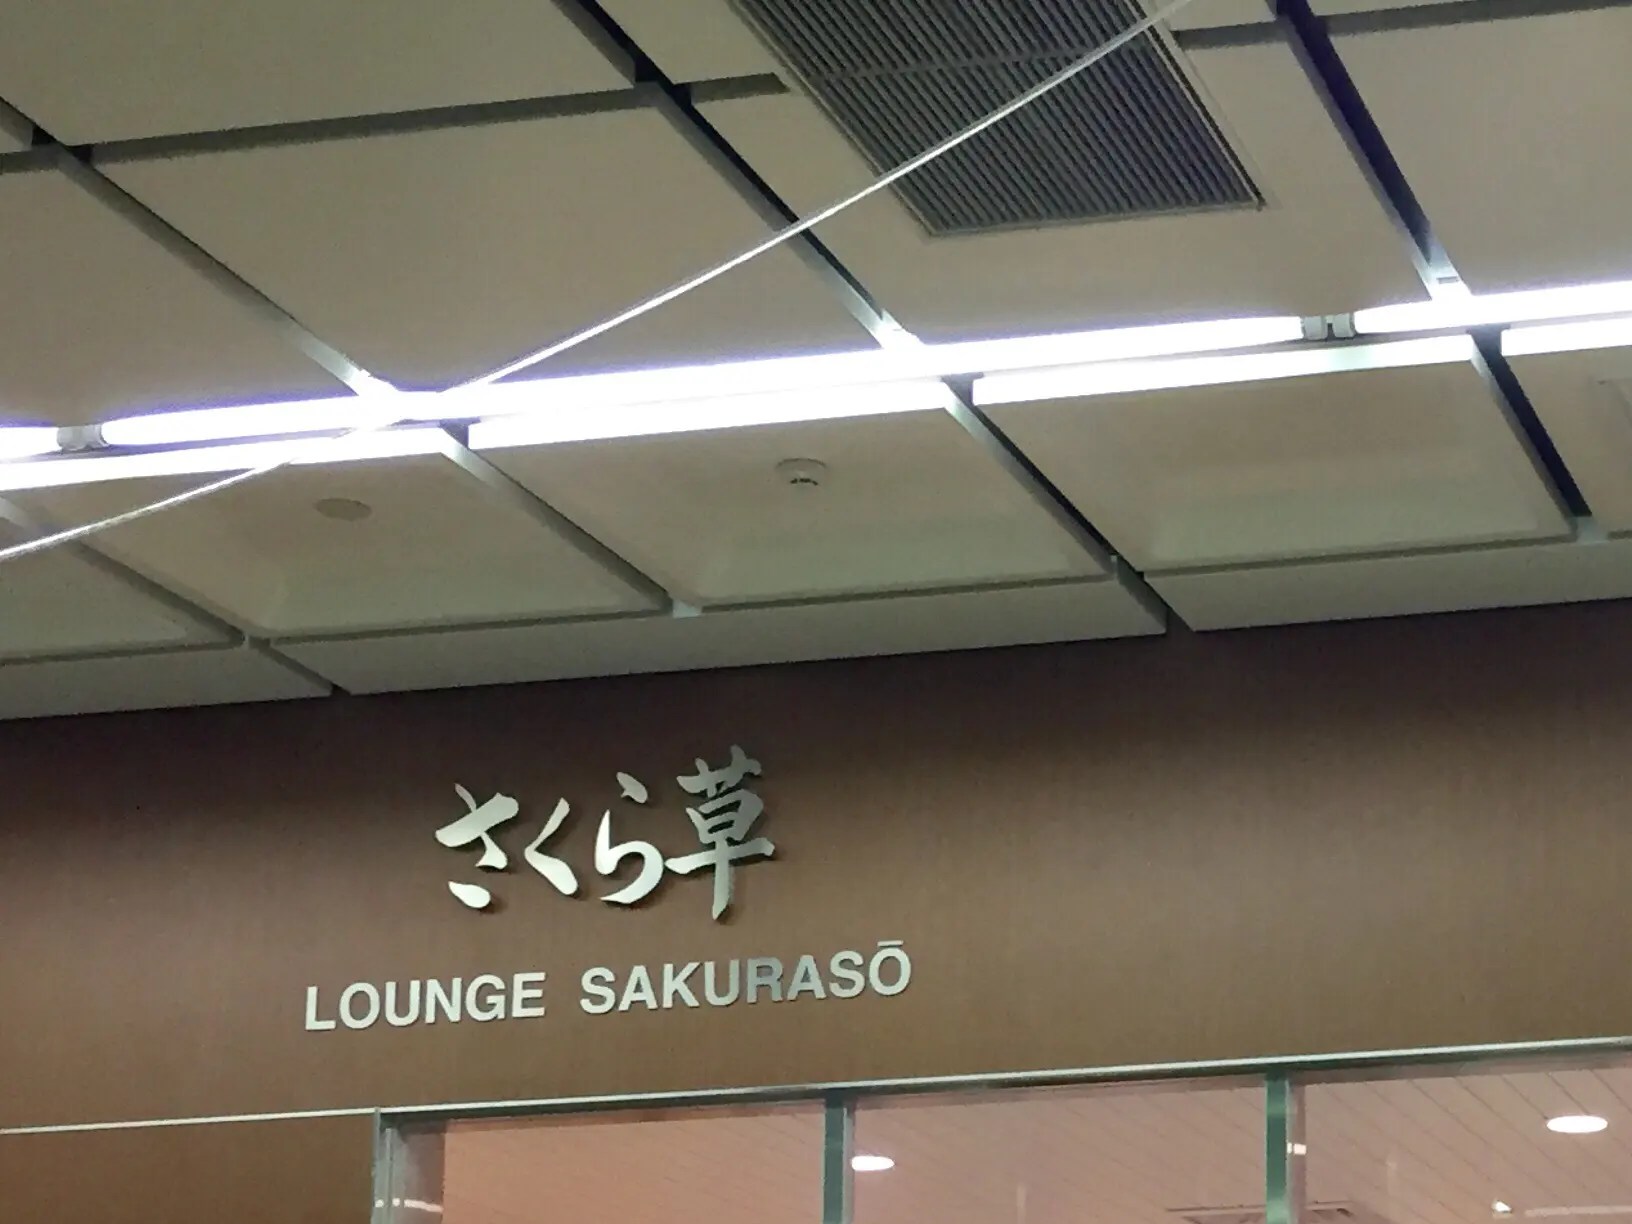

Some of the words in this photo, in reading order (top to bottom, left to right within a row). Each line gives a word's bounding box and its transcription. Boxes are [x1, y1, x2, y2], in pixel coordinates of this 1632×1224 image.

[435, 745, 775, 920] さくら草
[304, 972, 546, 1031] LOUNGE
[580, 940, 912, 1015] SAKURASŌ
